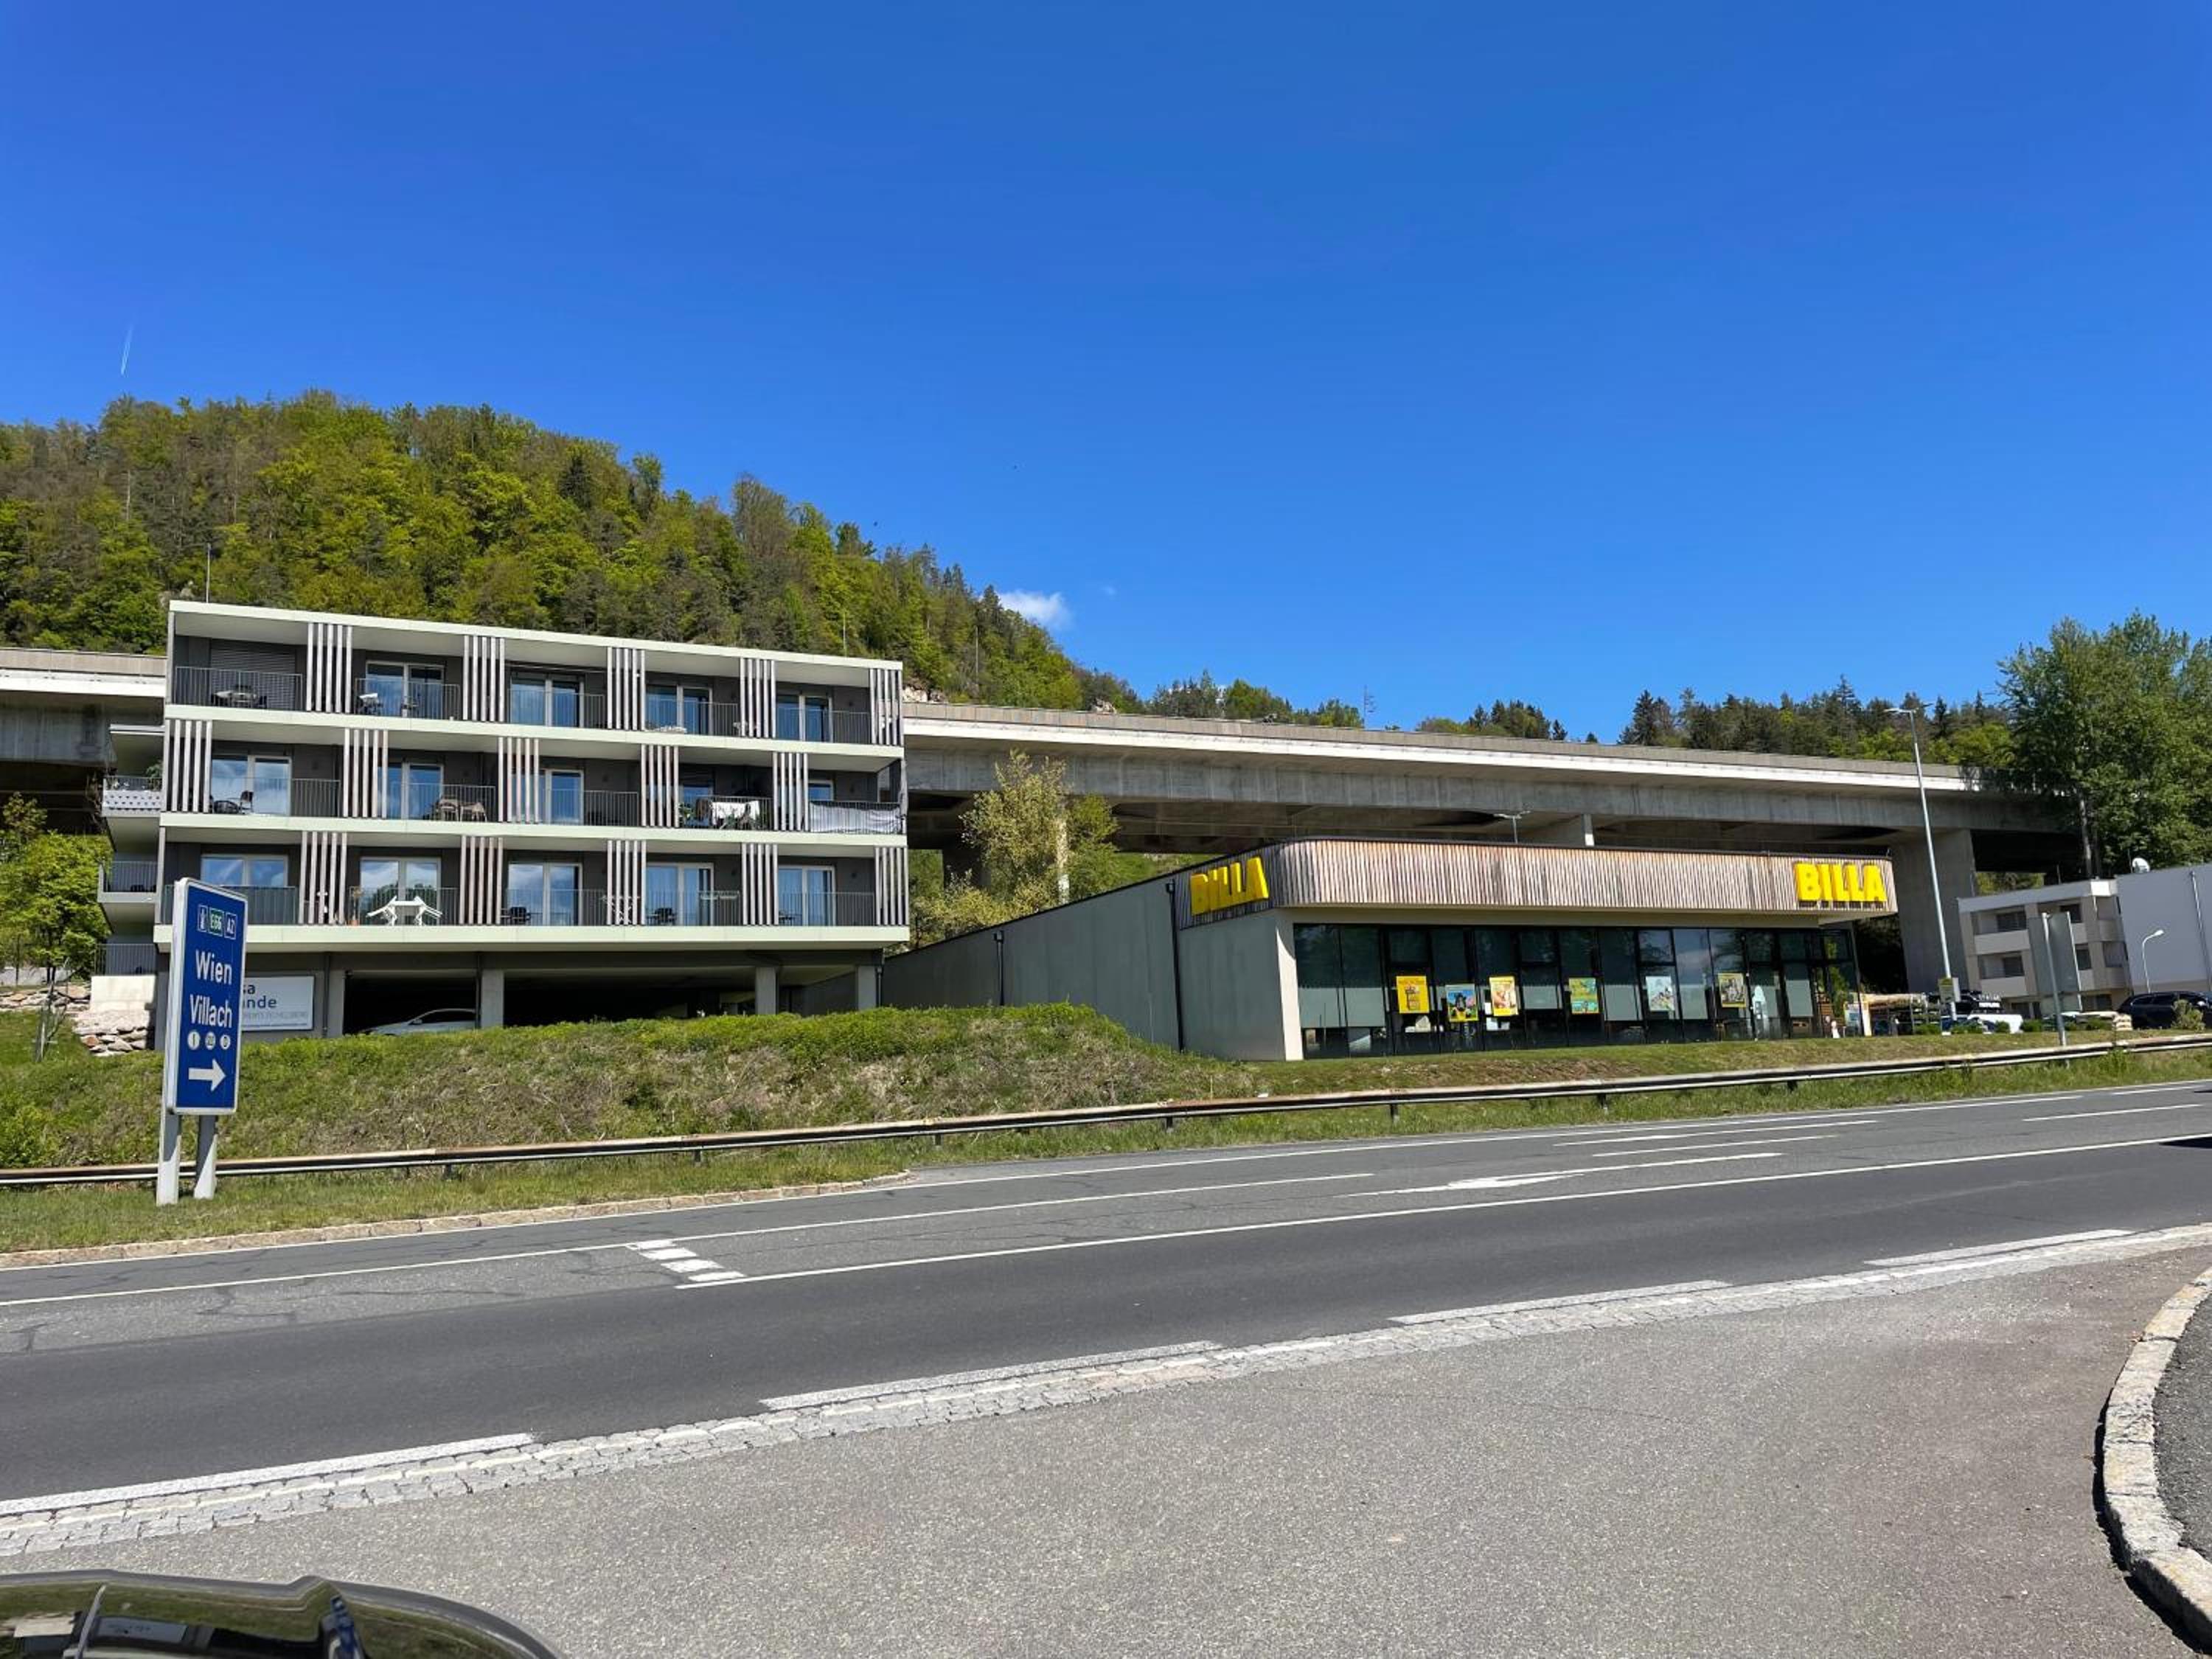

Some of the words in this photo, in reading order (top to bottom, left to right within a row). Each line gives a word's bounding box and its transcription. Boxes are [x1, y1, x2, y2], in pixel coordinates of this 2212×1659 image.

[1191, 856, 1269, 916] BILLA
[1794, 863, 1887, 902] BILLA
[195, 949, 232, 985] Wien
[189, 994, 232, 1029] Villach
